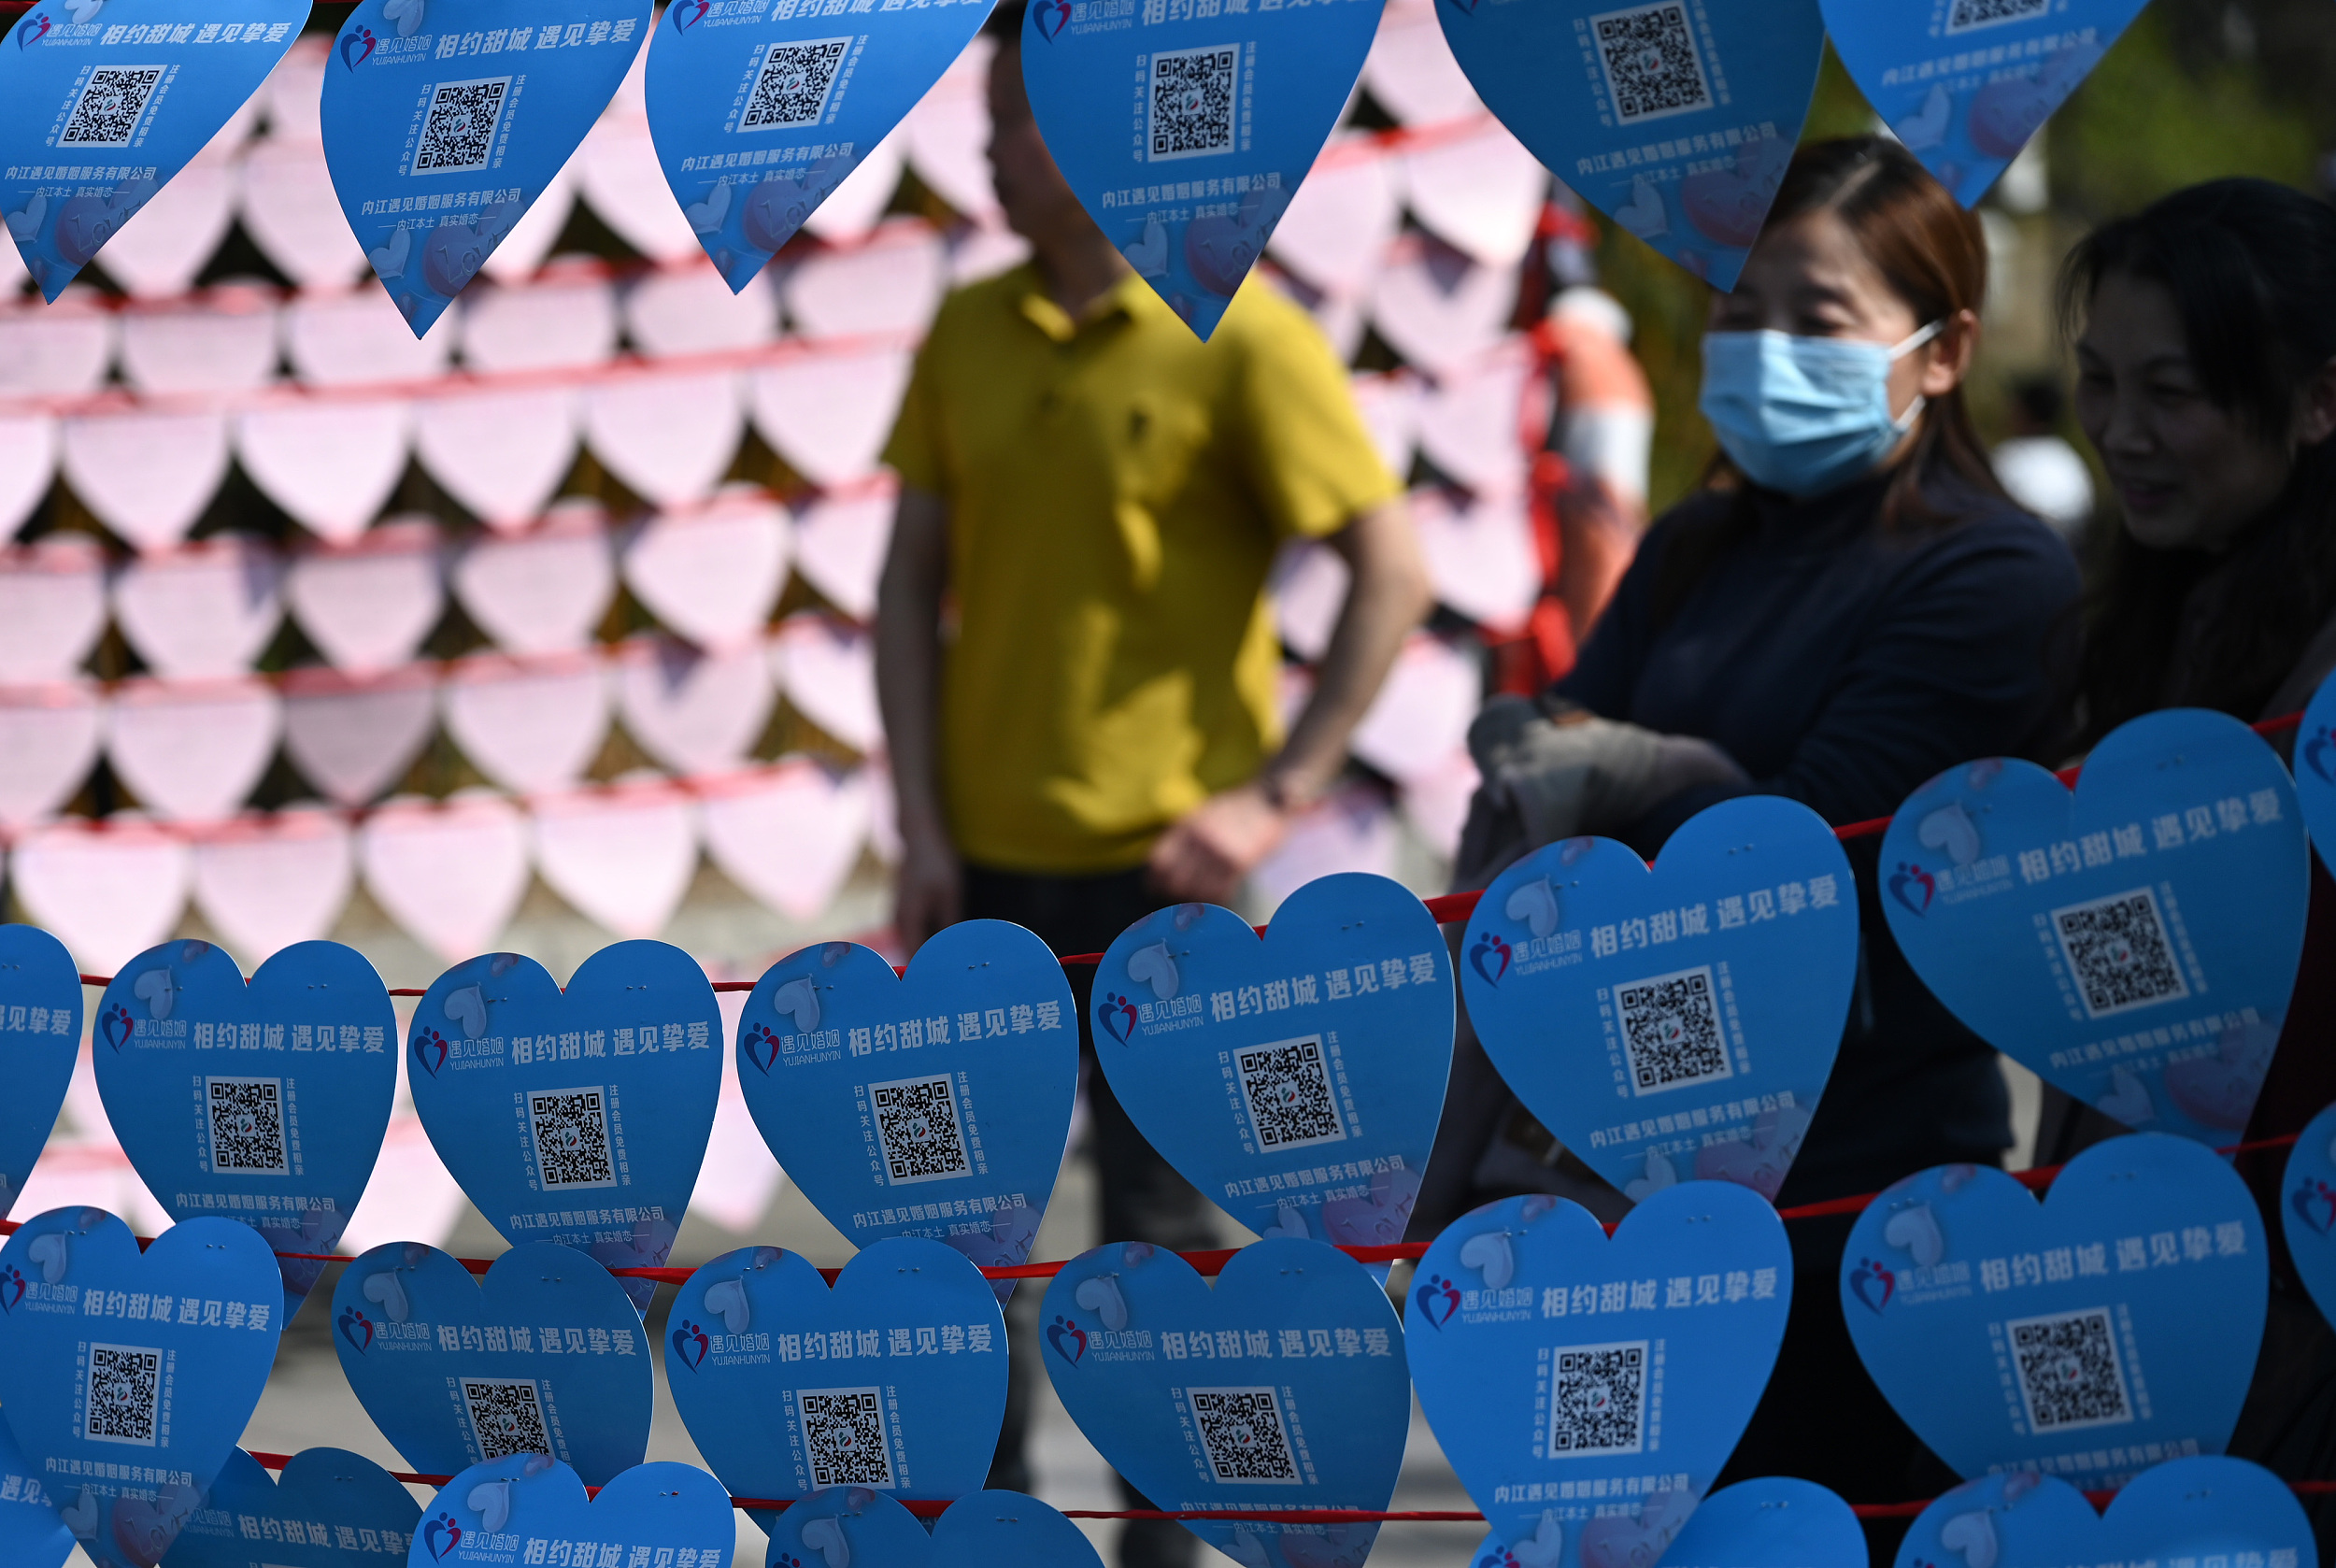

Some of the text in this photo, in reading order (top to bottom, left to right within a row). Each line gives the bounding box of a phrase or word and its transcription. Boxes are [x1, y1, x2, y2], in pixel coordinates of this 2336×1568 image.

[47, 22, 102, 36] 遇见婚姻
[101, 21, 292, 45] 相约甜城 遇见挚爱
[704, 16, 762, 27] YUJIANHUNYIN
[374, 35, 432, 54] 遇见婚姻
[435, 18, 637, 59] 相约甜城 遇见挚爱
[373, 53, 426, 65] YUJIANHUNYIN
[724, 45, 765, 133] 扫码关注公众号
[46, 66, 92, 146] 扫码关注公众号
[134, 64, 180, 147] 注册会员免费相亲
[398, 84, 432, 176] 扫码关注公众号
[492, 75, 526, 168] 注册会员免费相亲
[681, 143, 854, 171] 内江遇见婚姻服务有限公司
[5, 166, 156, 181] 内江遇见婚姻服务有限公司
[717, 167, 806, 187] 内江本土 真实婚恋
[35, 186, 113, 197] 内江本土 真实婚恋
[362, 188, 520, 215] 内江遇见婚姻服务有限公司
[1104, 173, 1281, 207] 内江遇见婚姻服务有限公司
[396, 213, 478, 232] 内江本土 真实婚恋
[2018, 824, 2146, 883] 相约甜城
[1210, 952, 1436, 1021] 相约甜城 遇见挚爱
[1139, 994, 1202, 1022] 遇见婚姻
[135, 1019, 186, 1036] 遇见婚姻
[194, 1022, 384, 1052] 相约甜城 遇见挚爱
[848, 1001, 1061, 1057] 相约甜城 遇见挚爱
[1142, 1016, 1204, 1035] YUJIANHUNYIN
[134, 1039, 185, 1048] YUJIANHUNYIN
[449, 1037, 504, 1058] 遇见婚姻
[512, 1021, 709, 1064] 相约甜城 遇见挚爱
[781, 1029, 840, 1054] 遇见婚姻
[450, 1058, 504, 1070] YUJIANHUNYIN
[783, 1050, 841, 1066] YUJIANHUNYIN
[1327, 1031, 1362, 1137] 注册会员免费相亲
[1218, 1051, 1254, 1154] 扫码关注公众号
[193, 1076, 208, 1171] 扫码关注公众号
[287, 1077, 303, 1175] 注册会员免费相亲
[609, 1084, 631, 1185] 注册会员免费相亲
[854, 1085, 883, 1186] 扫码关注公众号
[958, 1071, 988, 1174] 注册会员免费相亲
[514, 1092, 537, 1190] 扫码关注公众号
[1225, 1155, 1406, 1197] 内江遇见婚姻服务有限公司
[178, 1192, 335, 1213] 内江遇见婚姻服务有限公司
[854, 1193, 1028, 1228] 内江遇见婚姻服务有限公司
[1276, 1185, 1370, 1209] 内江本土 真实婚恋
[262, 1217, 302, 1230] 真实婚恋
[510, 1206, 665, 1229] 内江遇见婚姻服务有限公司
[948, 1220, 992, 1236] 真实婚恋
[552, 1230, 634, 1246] 内江本土 真实婚恋
[1980, 1243, 2108, 1291] 相约甜城
[25, 1282, 78, 1302] 遇见婚姻
[24, 1302, 75, 1314] YUJIANHUNYIN
[83, 1289, 269, 1331] 相约甜城 遇见挚爱
[374, 1322, 430, 1339] 遇见婚姻
[437, 1325, 636, 1355] 相约甜城 遇见挚爱
[710, 1333, 770, 1353] 遇见婚姻
[778, 1324, 992, 1361] 相约甜城 遇见挚爱
[1088, 1331, 1152, 1348] 遇见婚姻
[1161, 1328, 1392, 1360] 相约甜城 遇见挚爱
[377, 1342, 432, 1350] YUJIANHUNYIN
[712, 1354, 770, 1365] YUJIANHUNYIN
[73, 1341, 86, 1437] 扫码关注公众号
[541, 1379, 573, 1469] 注册会员免费相
[886, 1386, 910, 1488] 注册会员免费相亲
[1171, 1388, 1210, 1482] 扫码关注公众号
[782, 1390, 807, 1490] 扫码关注公众号
[47, 1457, 192, 1488] 内江遇见婚姻服务有限公司
[81, 1482, 158, 1502] 内江本土 真实婚恋
[237, 1514, 414, 1555] 相约甜城 遇见挚
[460, 1530, 520, 1552] 遇见婚姻
[1233, 1523, 1278, 1534] 内江本土
[457, 1549, 515, 1564] YUJIANHUNYIN
[523, 1537, 624, 1568] 相约甜城
